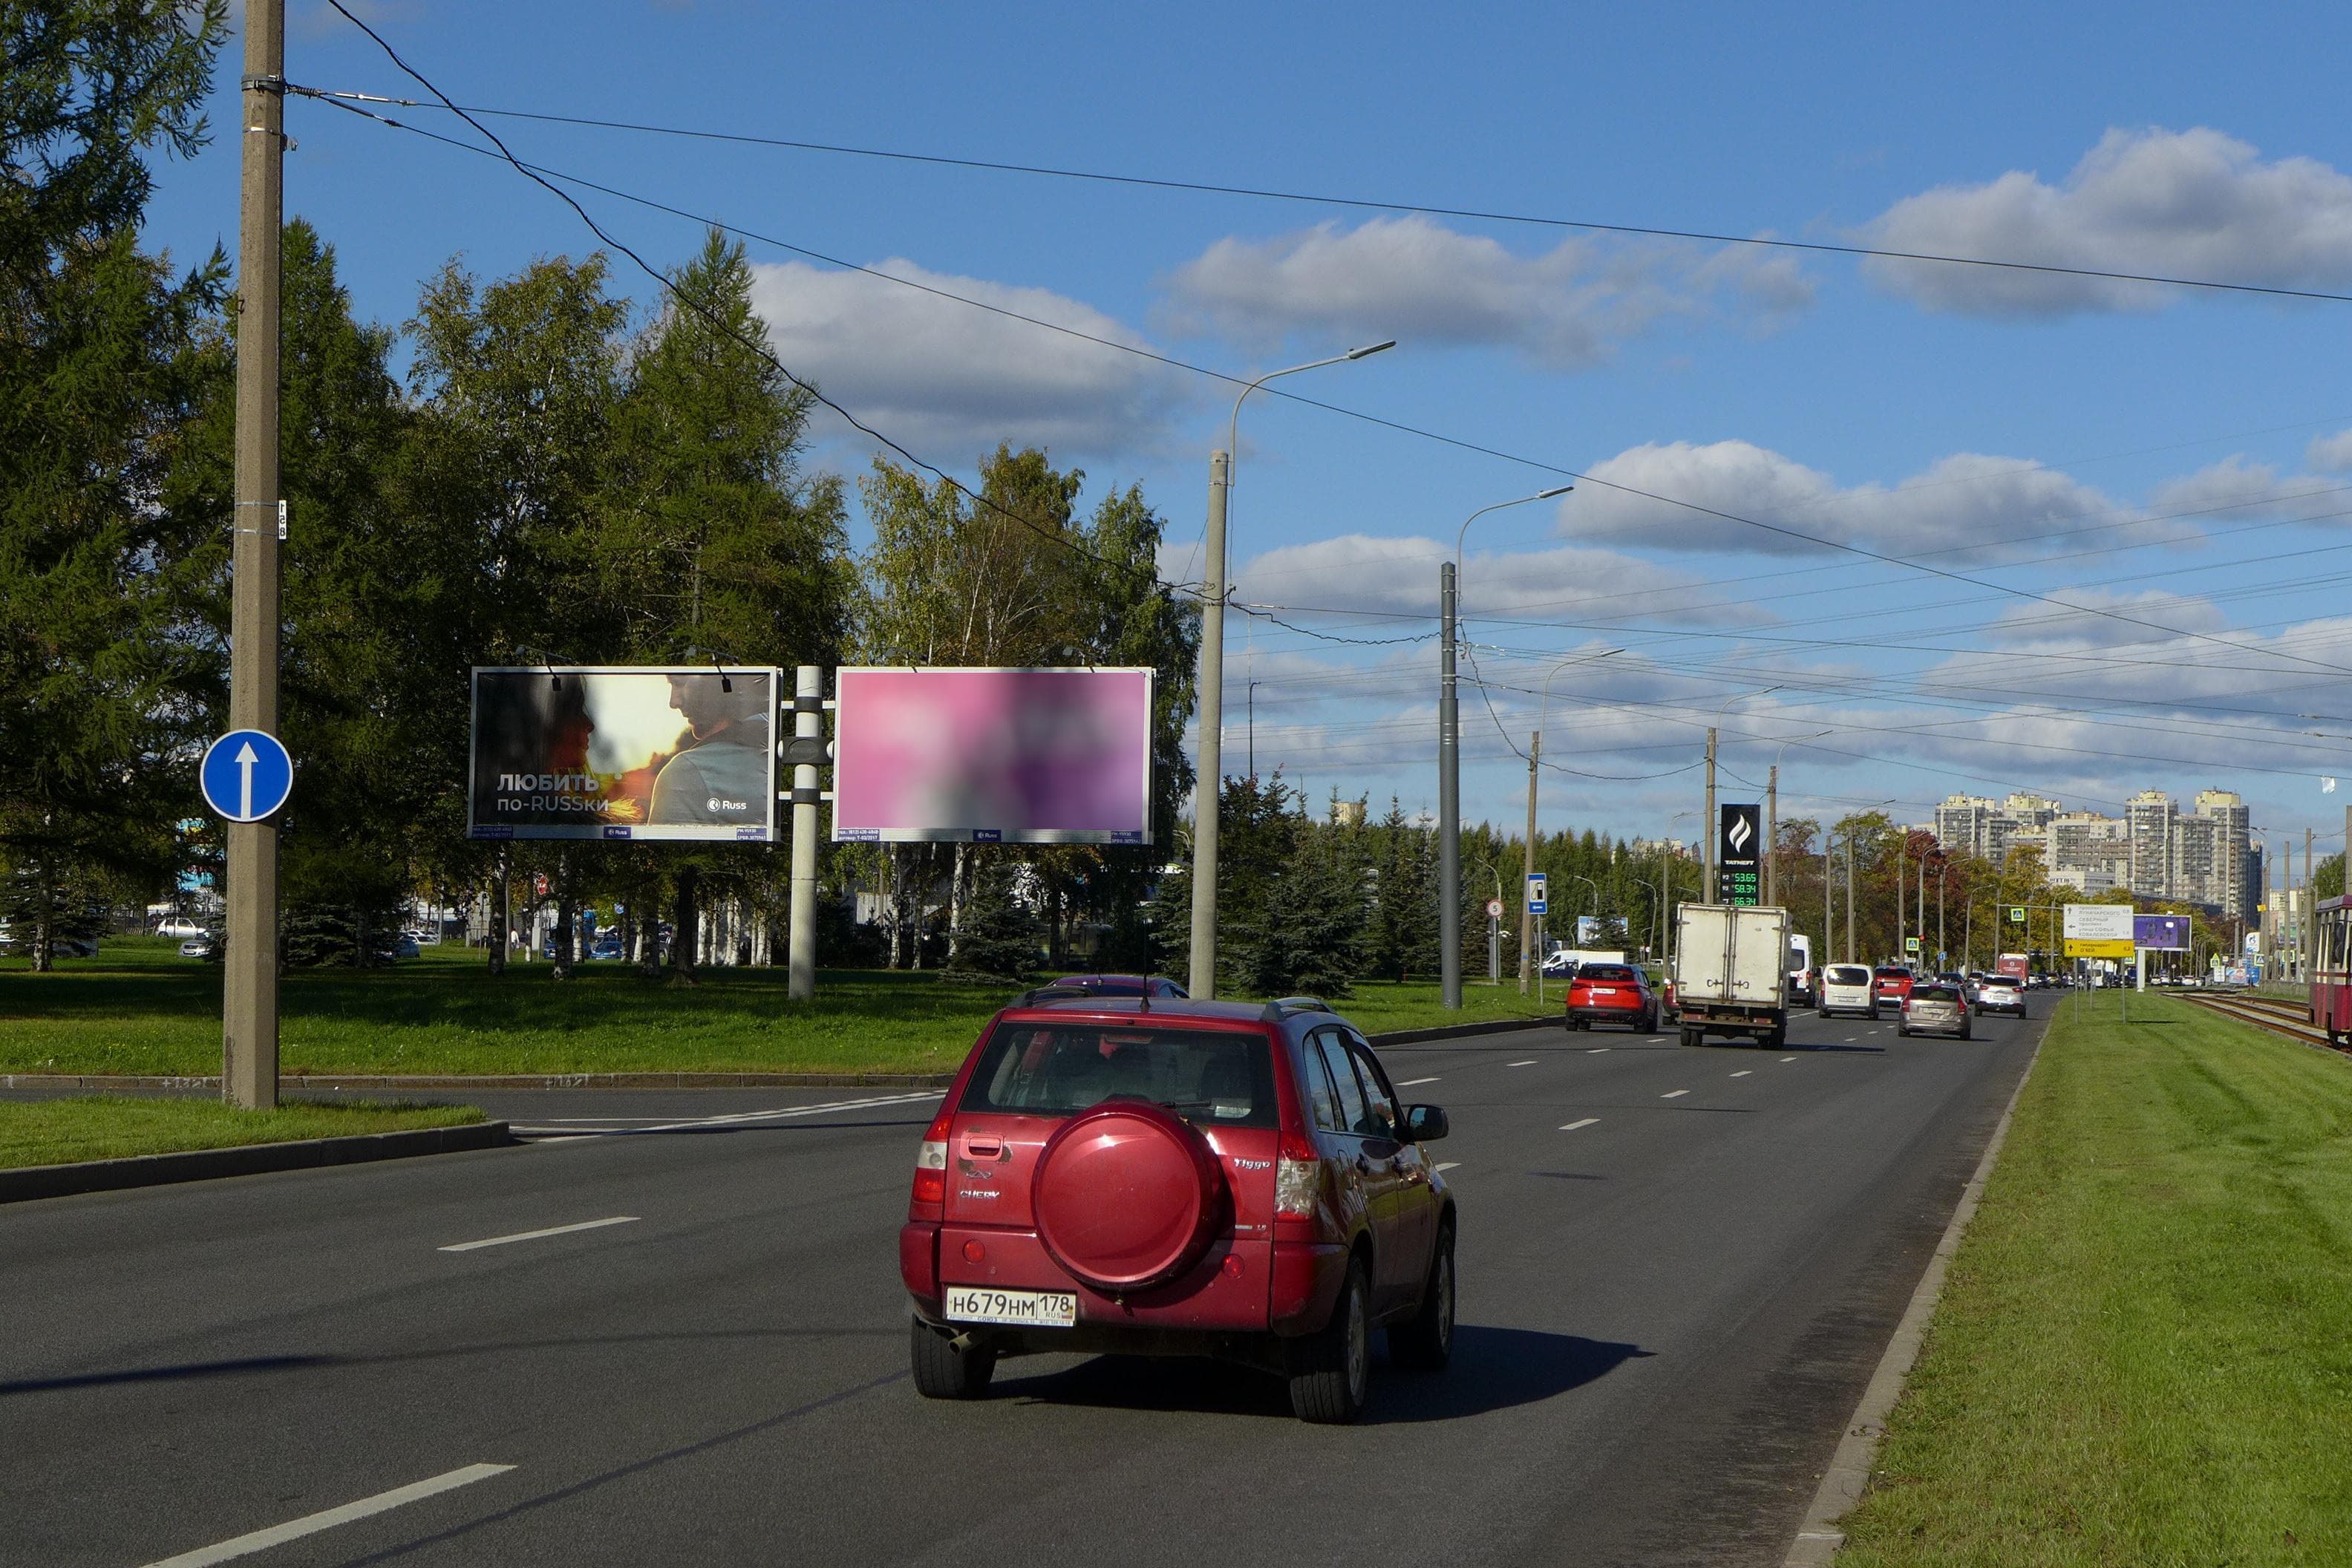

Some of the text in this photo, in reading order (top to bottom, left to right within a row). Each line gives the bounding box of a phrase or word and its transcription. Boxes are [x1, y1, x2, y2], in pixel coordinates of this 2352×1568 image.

[497, 774, 599, 791] ЛЮБИТЬ
[497, 796, 609, 811] по-RUSSки
[722, 800, 747, 810] Russ
[1734, 873, 1757, 882] 53.65
[1734, 884, 1757, 893] 58.34
[1734, 897, 1757, 906] 66.34
[1493, 904, 1498, 912] 5
[1234, 1158, 1271, 1169] Tiggo
[960, 1190, 1000, 1198] CHERY
[953, 1293, 1070, 1317] Н679НМ 178
